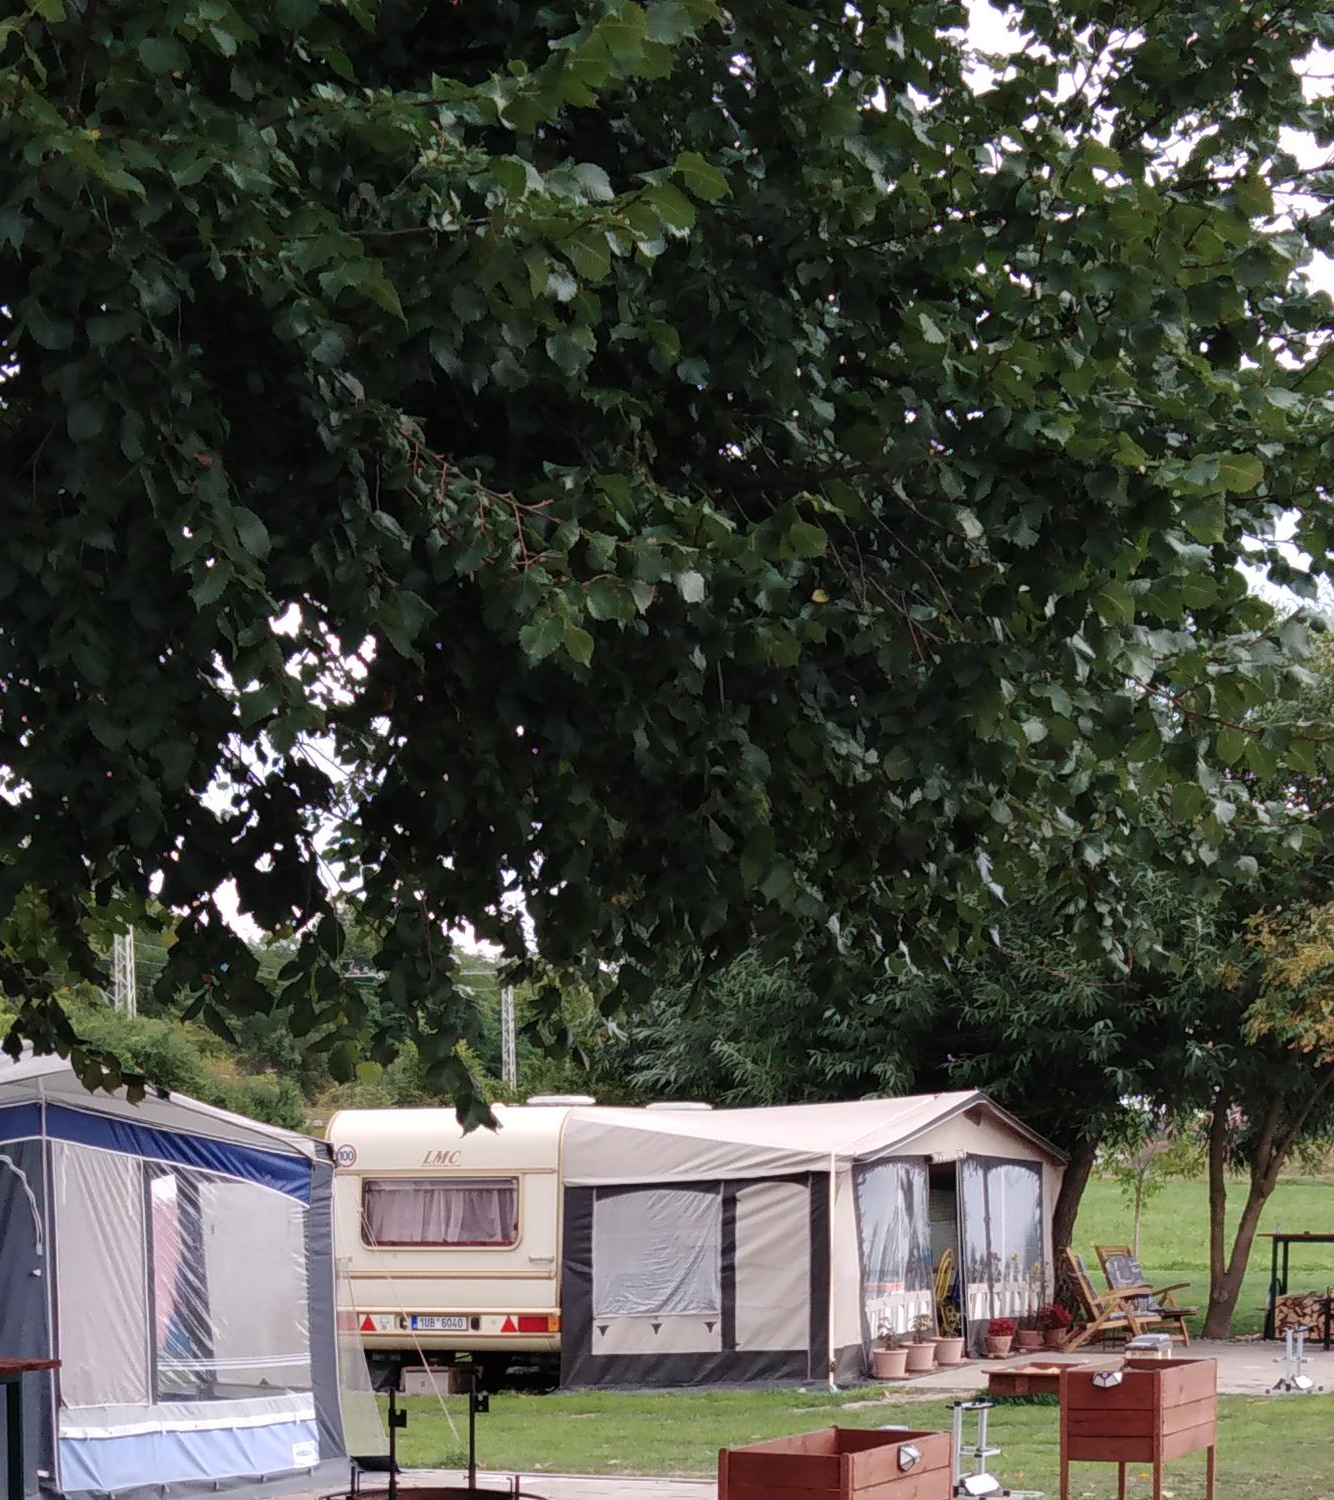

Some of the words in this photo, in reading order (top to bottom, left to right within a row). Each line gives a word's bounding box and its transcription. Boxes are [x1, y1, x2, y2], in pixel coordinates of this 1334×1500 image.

[339, 1150, 354, 1161] 100
[422, 1150, 462, 1164] LMC
[420, 1316, 436, 1328] 1UB
[441, 1317, 463, 1328] 6040
